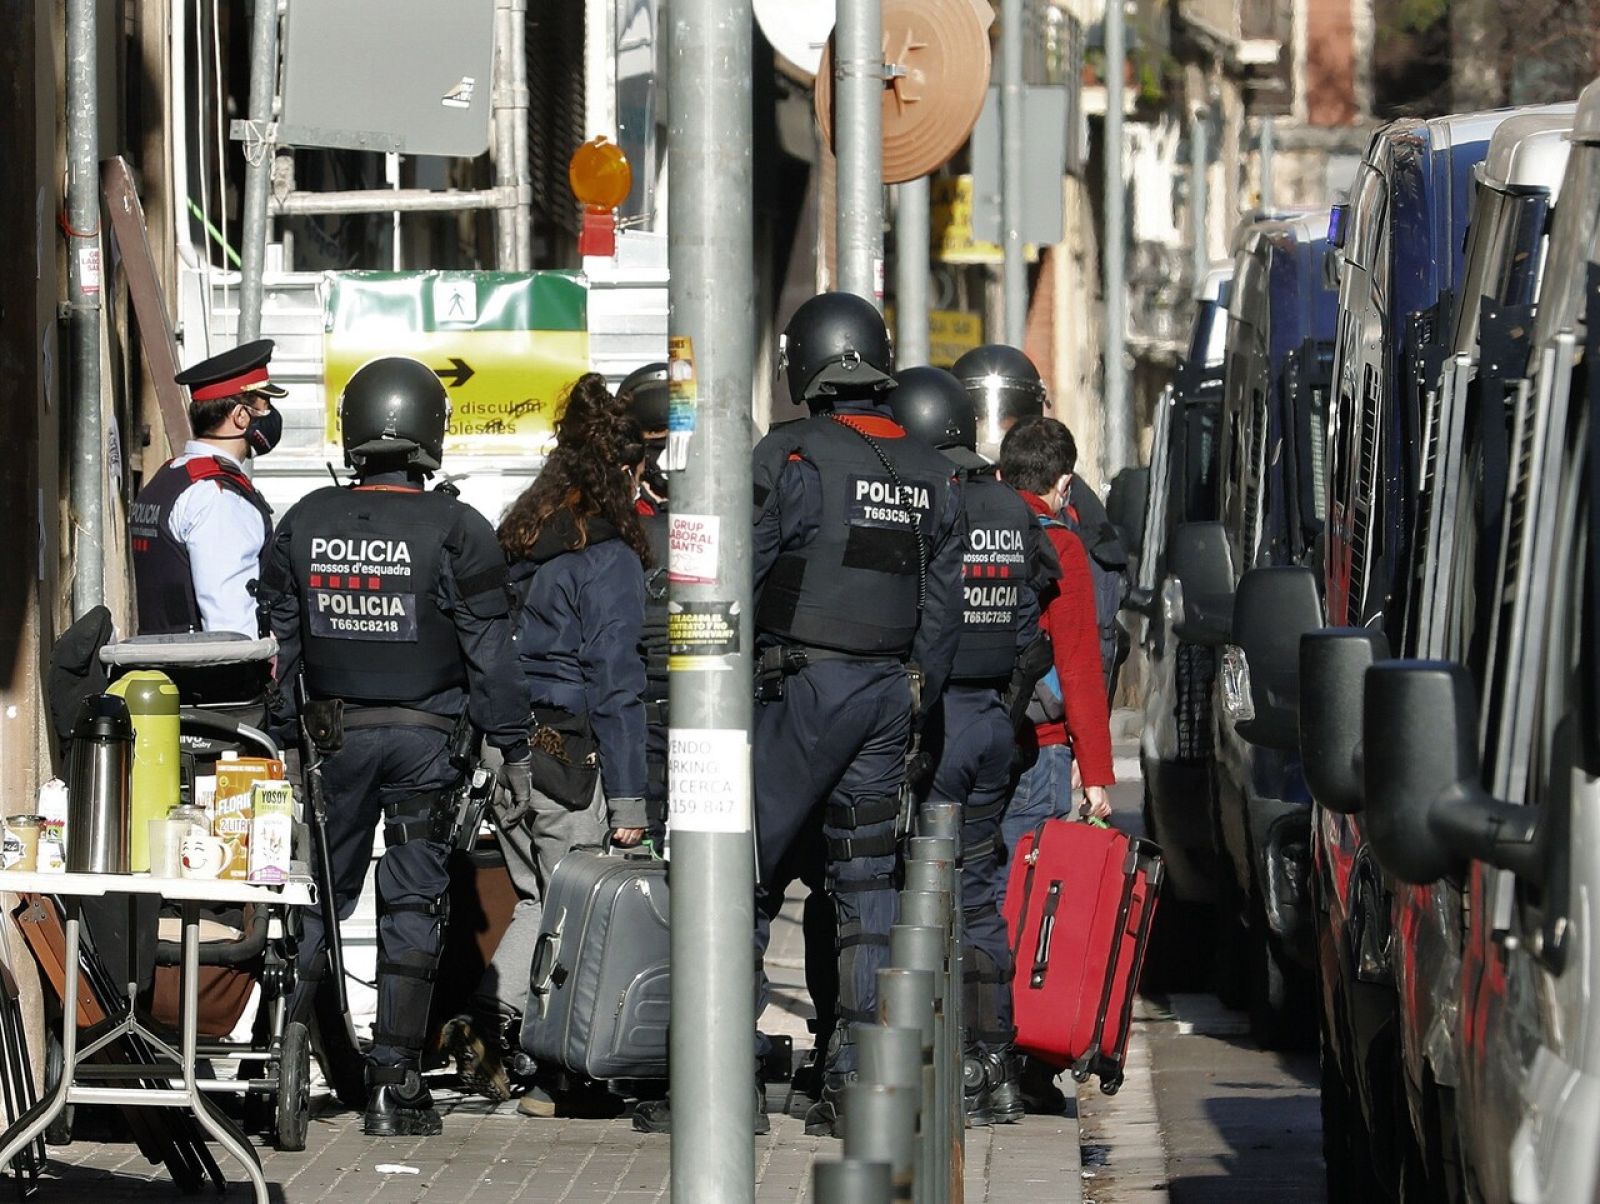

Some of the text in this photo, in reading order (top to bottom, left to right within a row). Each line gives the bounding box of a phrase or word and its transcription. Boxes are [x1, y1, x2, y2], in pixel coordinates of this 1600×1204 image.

[674, 519, 704, 531] GRUP
[671, 539, 704, 554] SANTS
[969, 529, 1024, 551] OLICIA
[311, 538, 411, 563] POLICIA
[310, 562, 411, 577] mossos d'esquadra
[318, 593, 406, 616] POLICIA
[329, 618, 399, 633] T663C8218
[669, 623, 706, 631] ONTRATO
[192, 741, 212, 749] baby
[679, 780, 732, 793] CERCA
[261, 790, 288, 804] YOSOY
